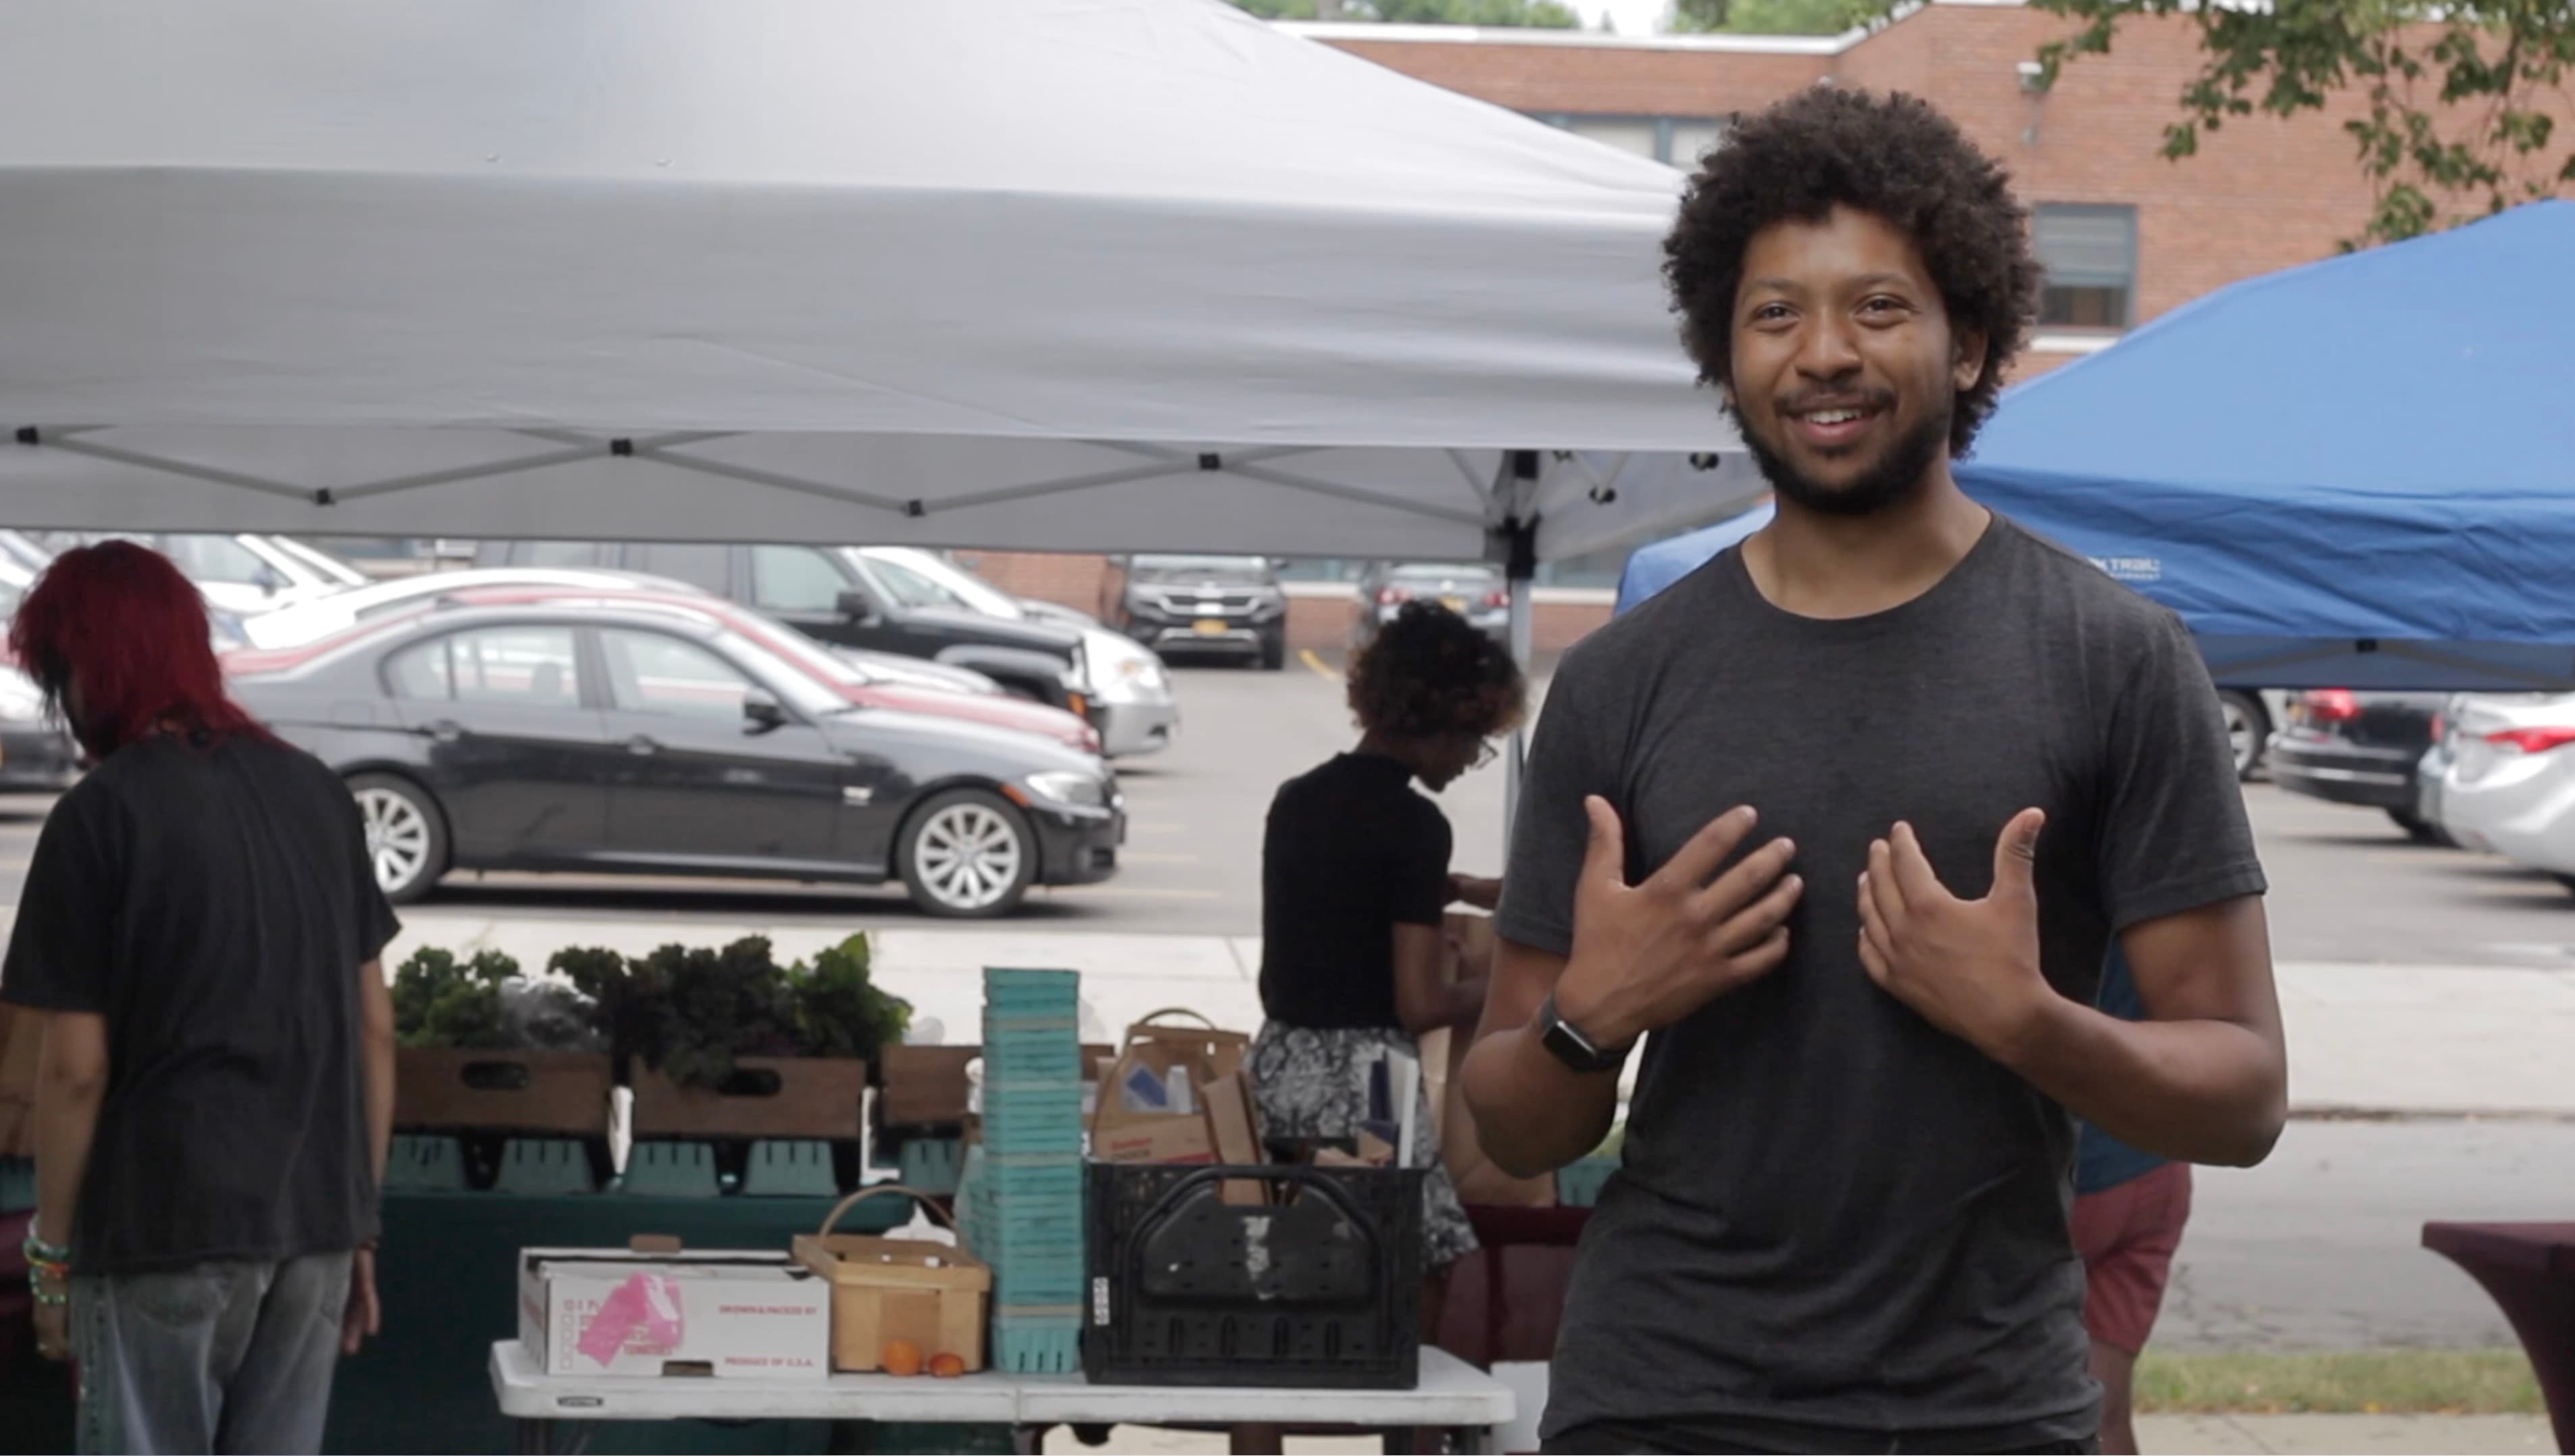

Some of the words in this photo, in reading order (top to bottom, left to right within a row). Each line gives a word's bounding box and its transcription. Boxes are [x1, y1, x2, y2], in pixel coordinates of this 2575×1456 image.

[724, 1356, 768, 1366] PRODUCE
[770, 1357, 783, 1366] OF
[785, 1357, 815, 1367] U.S.A.
